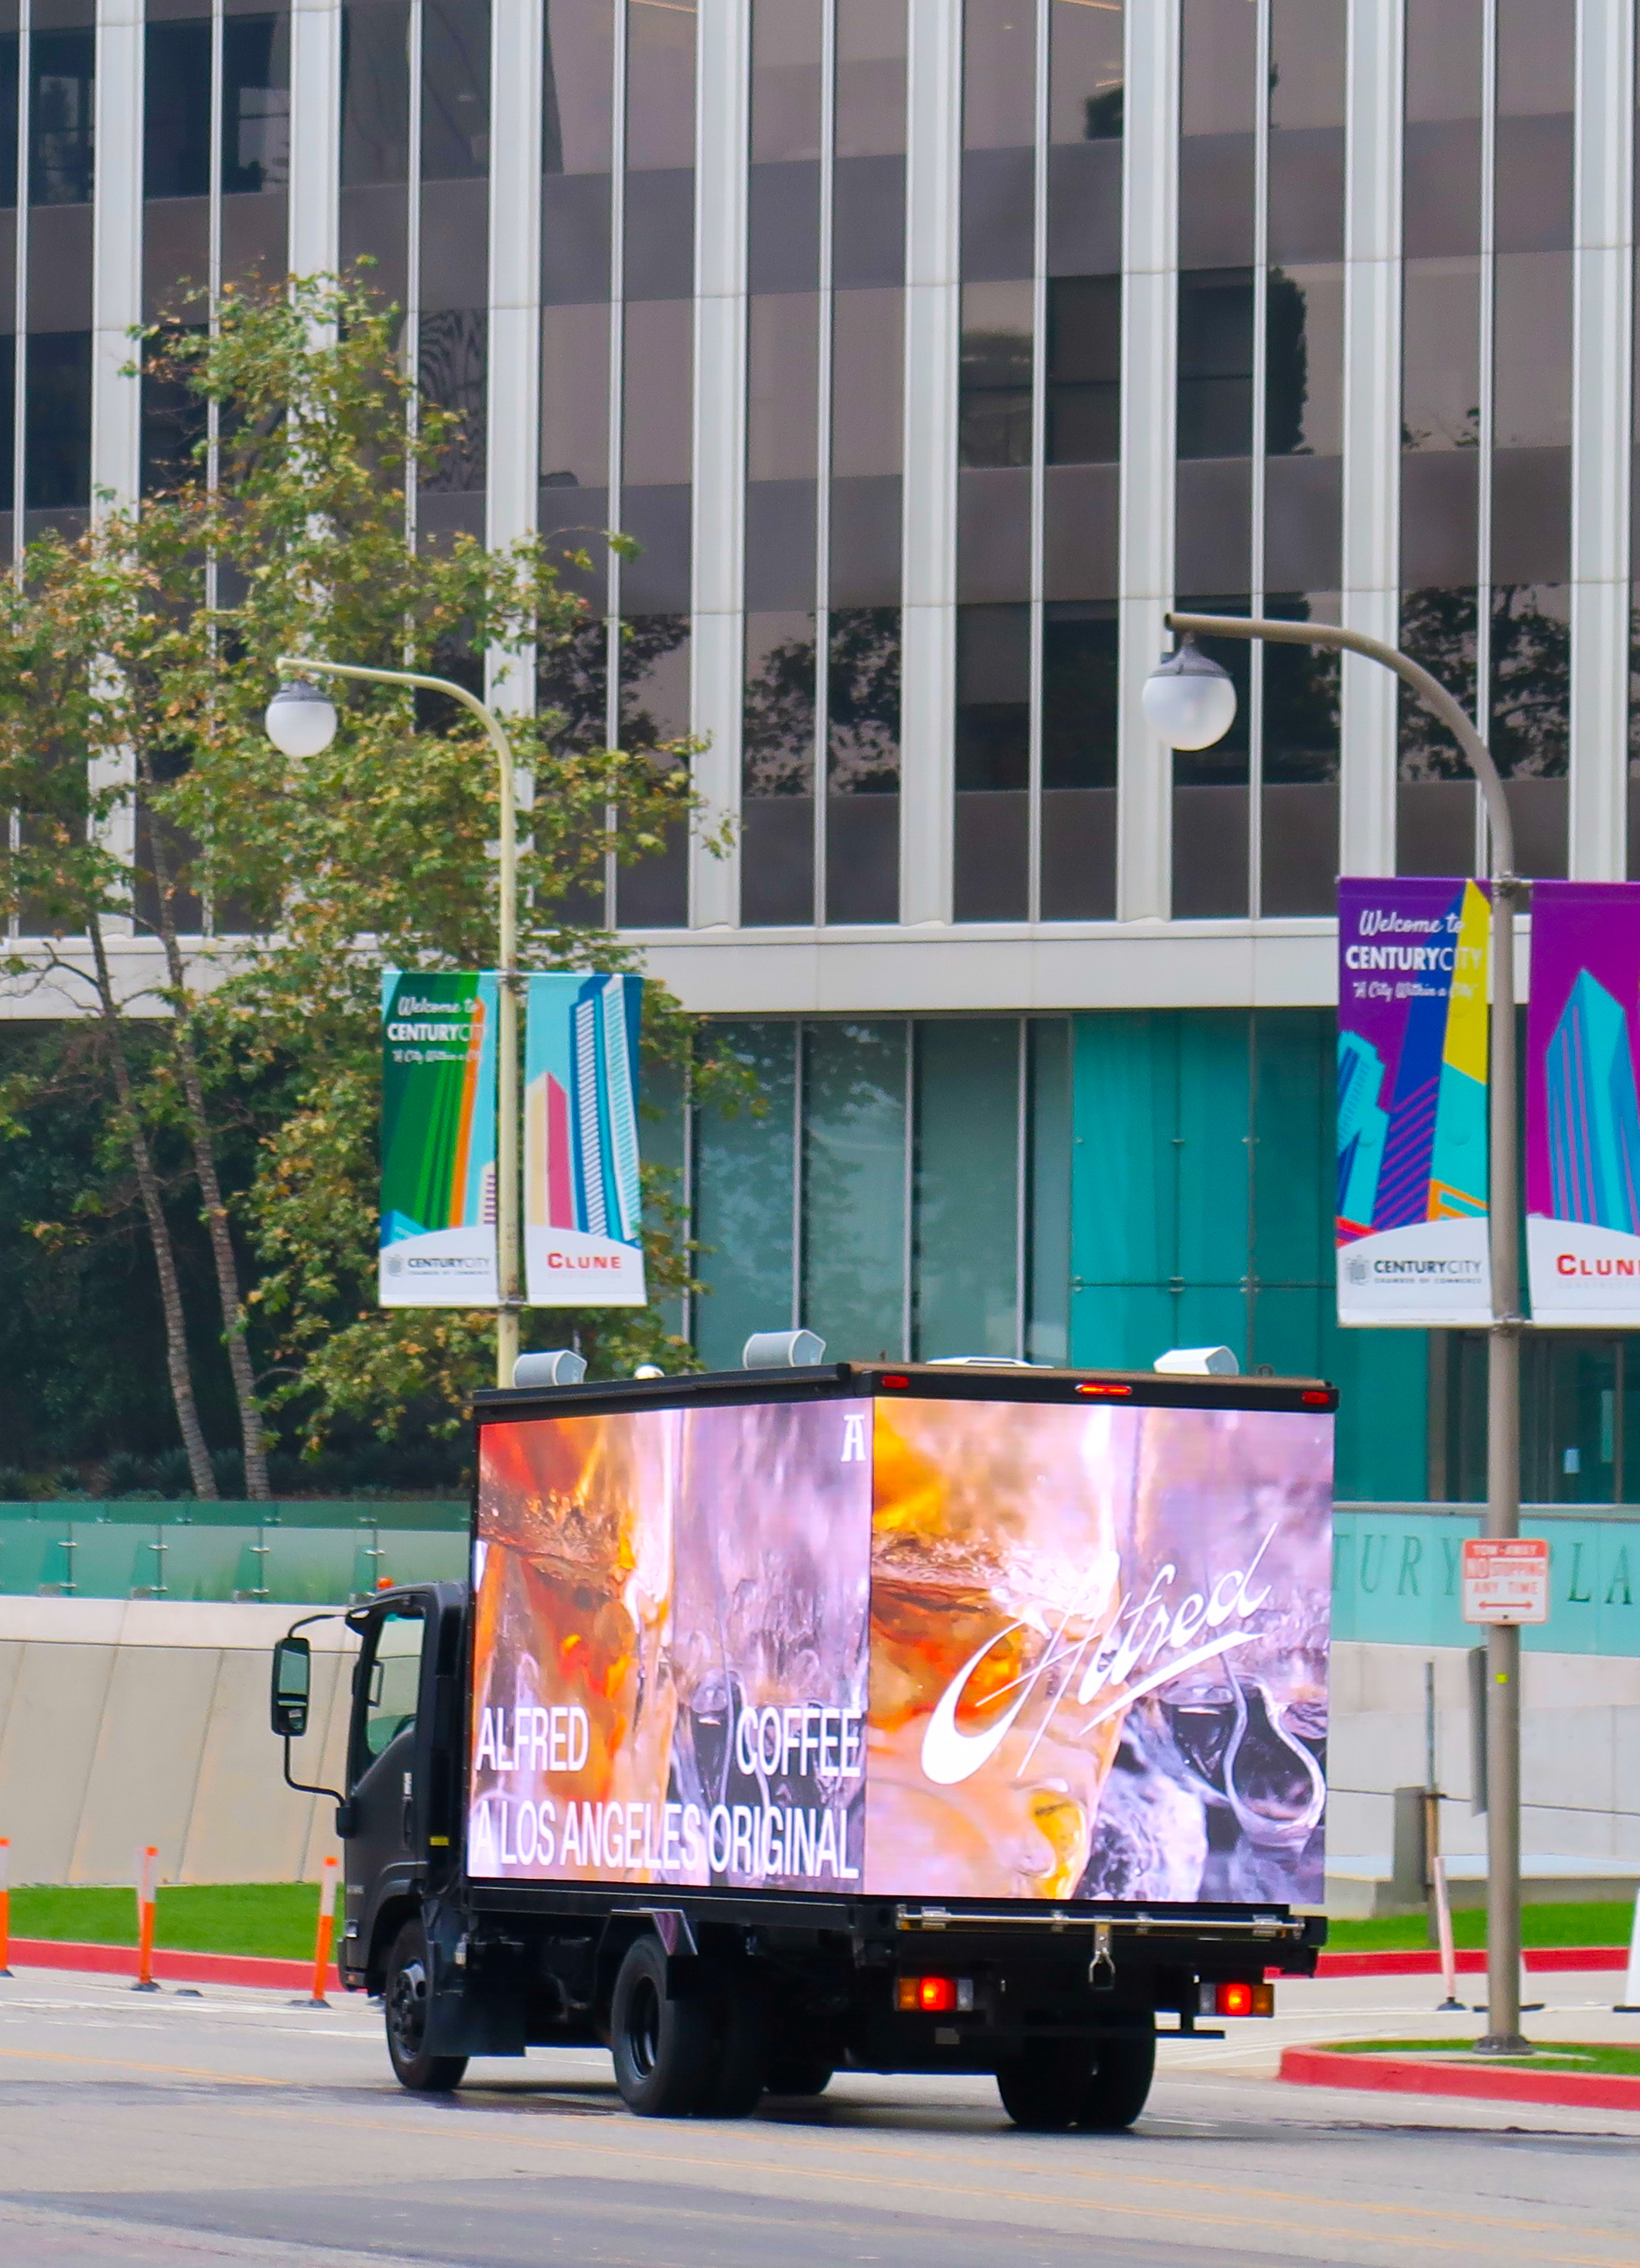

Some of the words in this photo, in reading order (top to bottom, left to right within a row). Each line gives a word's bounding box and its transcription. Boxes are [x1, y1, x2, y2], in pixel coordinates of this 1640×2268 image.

[1359, 909, 1444, 936] Welcome
[1445, 912, 1465, 933] to
[1346, 945, 1484, 971] CENTURYCITY
[397, 996, 462, 1016] Welcome
[547, 1252, 622, 1269] CLUNE
[1374, 1260, 1482, 1274] CENTURYCITY
[1556, 1254, 1640, 1276] CLUN
[921, 1522, 1279, 1785] Alfred
[475, 1706, 589, 1771] ALFRED
[736, 1707, 861, 1778] COFFEE
[473, 1800, 501, 1865] A
[501, 1800, 556, 1867] LOS
[559, 1802, 701, 1872] ANGELES
[708, 1805, 859, 1880] ORIGINAL
